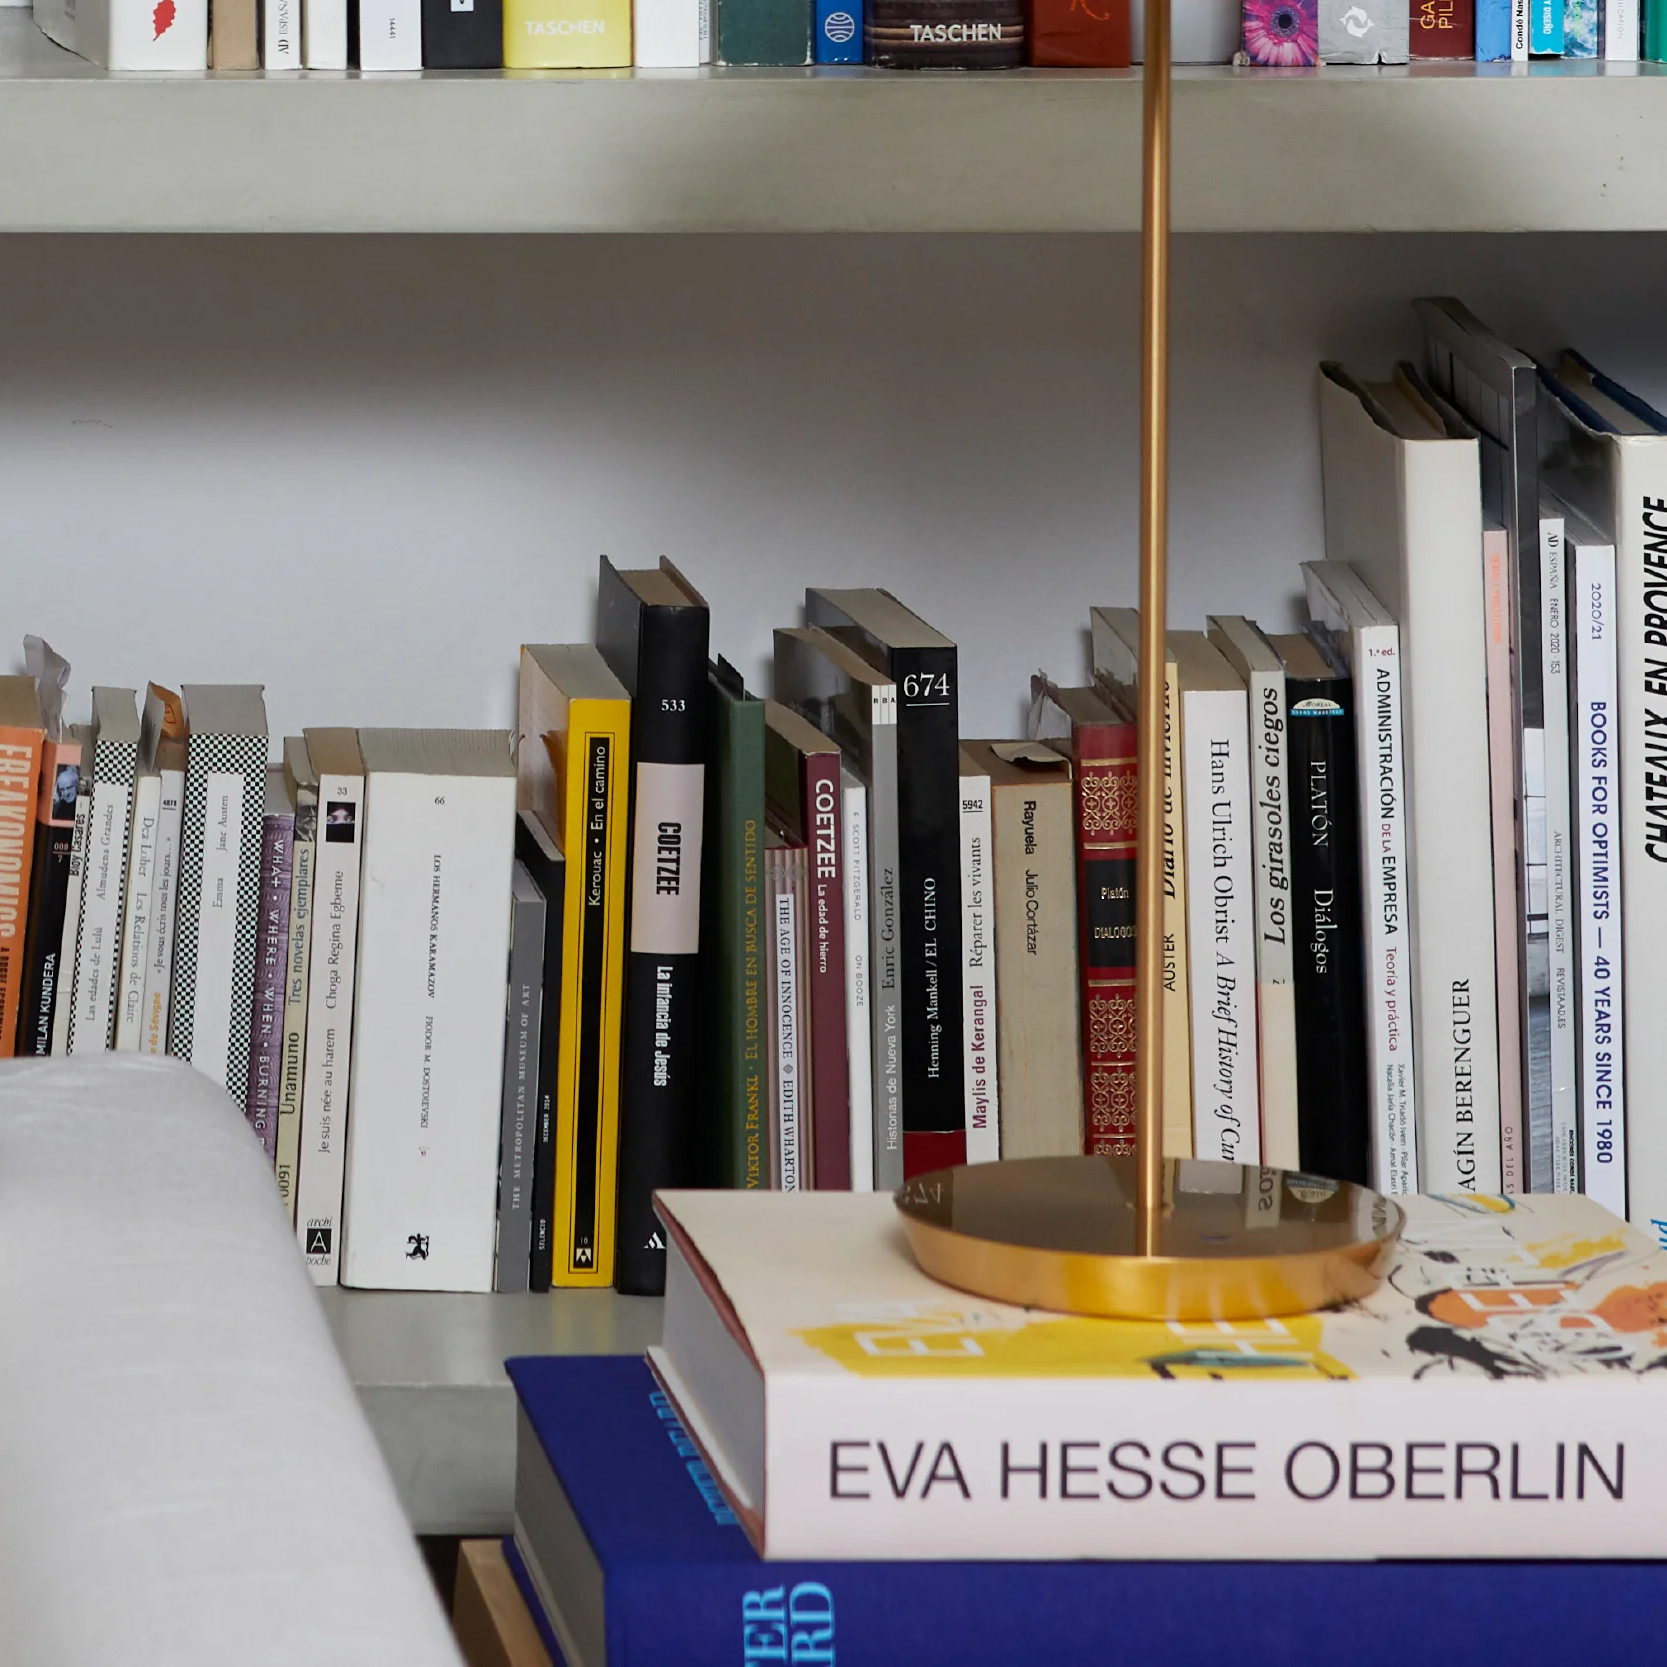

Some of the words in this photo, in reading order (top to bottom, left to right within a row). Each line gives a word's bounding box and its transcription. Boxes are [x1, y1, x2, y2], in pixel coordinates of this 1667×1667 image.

[662, 700, 686, 711] 533
[904, 673, 950, 696] 674
[1591, 701, 1607, 768] BOOKS
[593, 746, 606, 793] camino
[1210, 739, 1230, 794] Hans
[591, 798, 604, 808] el
[1310, 761, 1331, 847] PLATÓN
[1591, 775, 1607, 814] FOR
[591, 814, 604, 830] En
[816, 779, 835, 878] COETZEE
[1024, 801, 1037, 854] Rayuela
[1211, 800, 1232, 864] Ulrich
[588, 851, 602, 906] Kerouac
[657, 822, 681, 895] COETZEE
[1592, 823, 1609, 920] OPTIMISTS
[293, 849, 310, 919] ejemplares
[330, 871, 344, 919] Egbeme
[1024, 869, 1039, 898] Julio
[780, 898, 790, 925] THE
[1025, 900, 1039, 955] Cortázar
[1213, 876, 1235, 943] Obrist
[1310, 889, 1337, 973] Diálogos
[291, 924, 305, 973] novelas
[328, 924, 342, 965] Regina
[780, 929, 791, 955] AGE
[1216, 951, 1232, 966] A
[39, 953, 55, 1013] KUNDERA
[326, 970, 340, 1009] Choga
[657, 967, 673, 980] La
[781, 959, 792, 977] OF
[1594, 955, 1610, 979] 40
[289, 978, 301, 1005] Tres
[655, 983, 673, 1029] infancia
[1212, 974, 1238, 1029] Brief
[36, 1016, 50, 1054] MILAN
[655, 1032, 671, 1047] de
[781, 980, 793, 1058] INNOCENCE
[1594, 987, 1611, 1045] YEARS
[654, 1051, 671, 1086] Jesús
[1213, 1027, 1239, 1098] History
[1452, 980, 1473, 1123] BERENGUER
[783, 1080, 794, 1122] EDITH
[1596, 1052, 1612, 1109] SINCE
[1219, 1104, 1240, 1127] of
[1596, 1119, 1612, 1163] 1980
[829, 1442, 971, 1501] EVA
[1000, 1442, 1256, 1502] HESSE
[1283, 1440, 1624, 1502] OBERLIN
